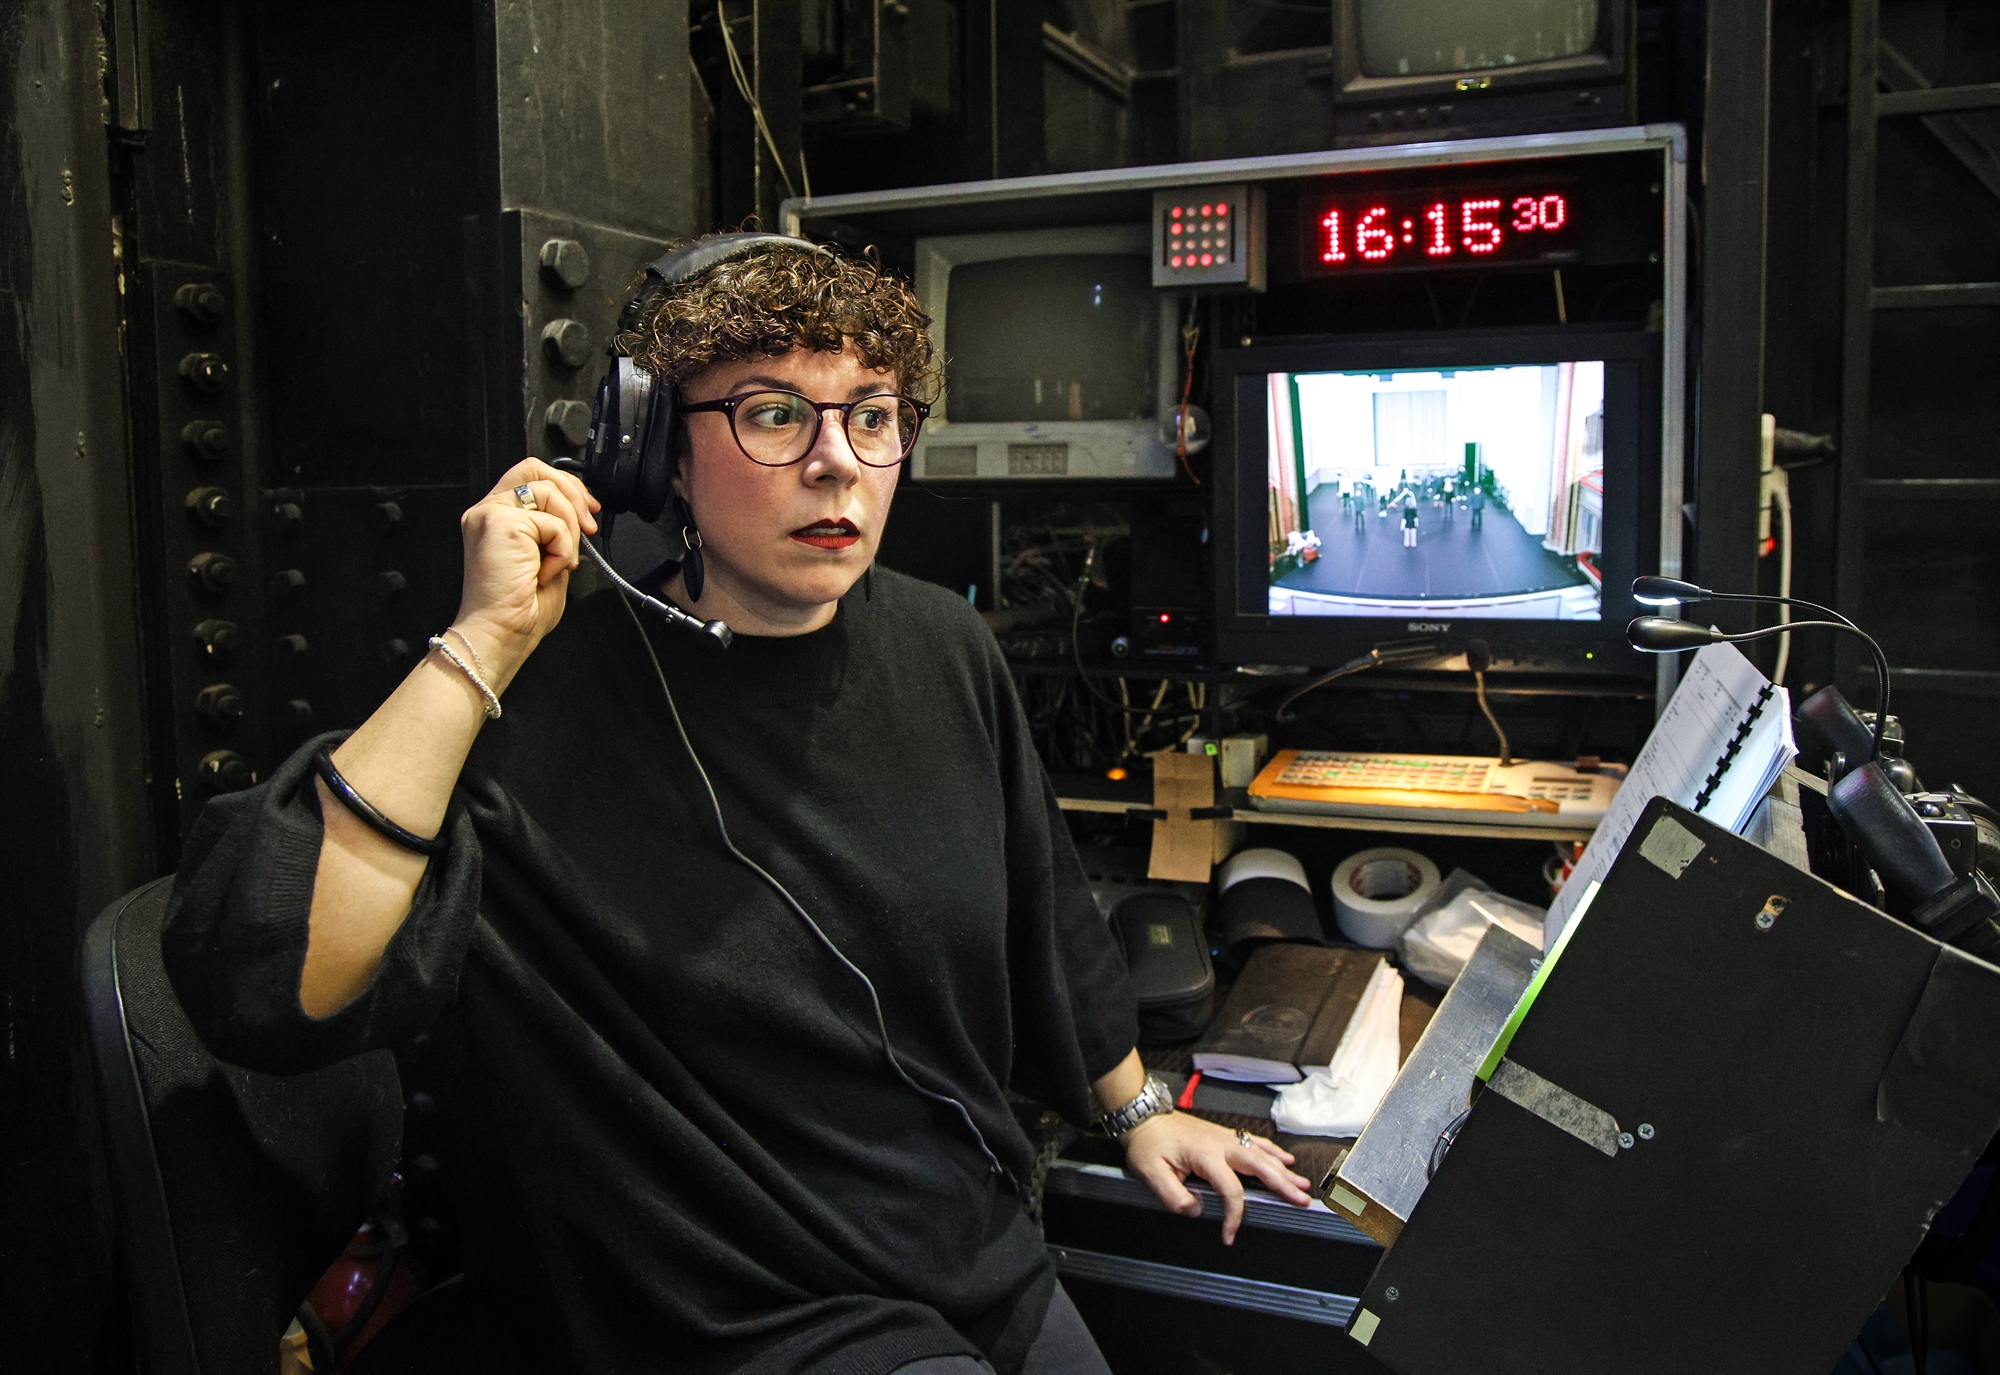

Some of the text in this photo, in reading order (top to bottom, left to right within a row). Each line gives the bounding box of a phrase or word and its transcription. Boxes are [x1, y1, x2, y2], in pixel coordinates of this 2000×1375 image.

[1321, 194, 1566, 262] 16:15 30
[1408, 622, 1451, 632] SONY
